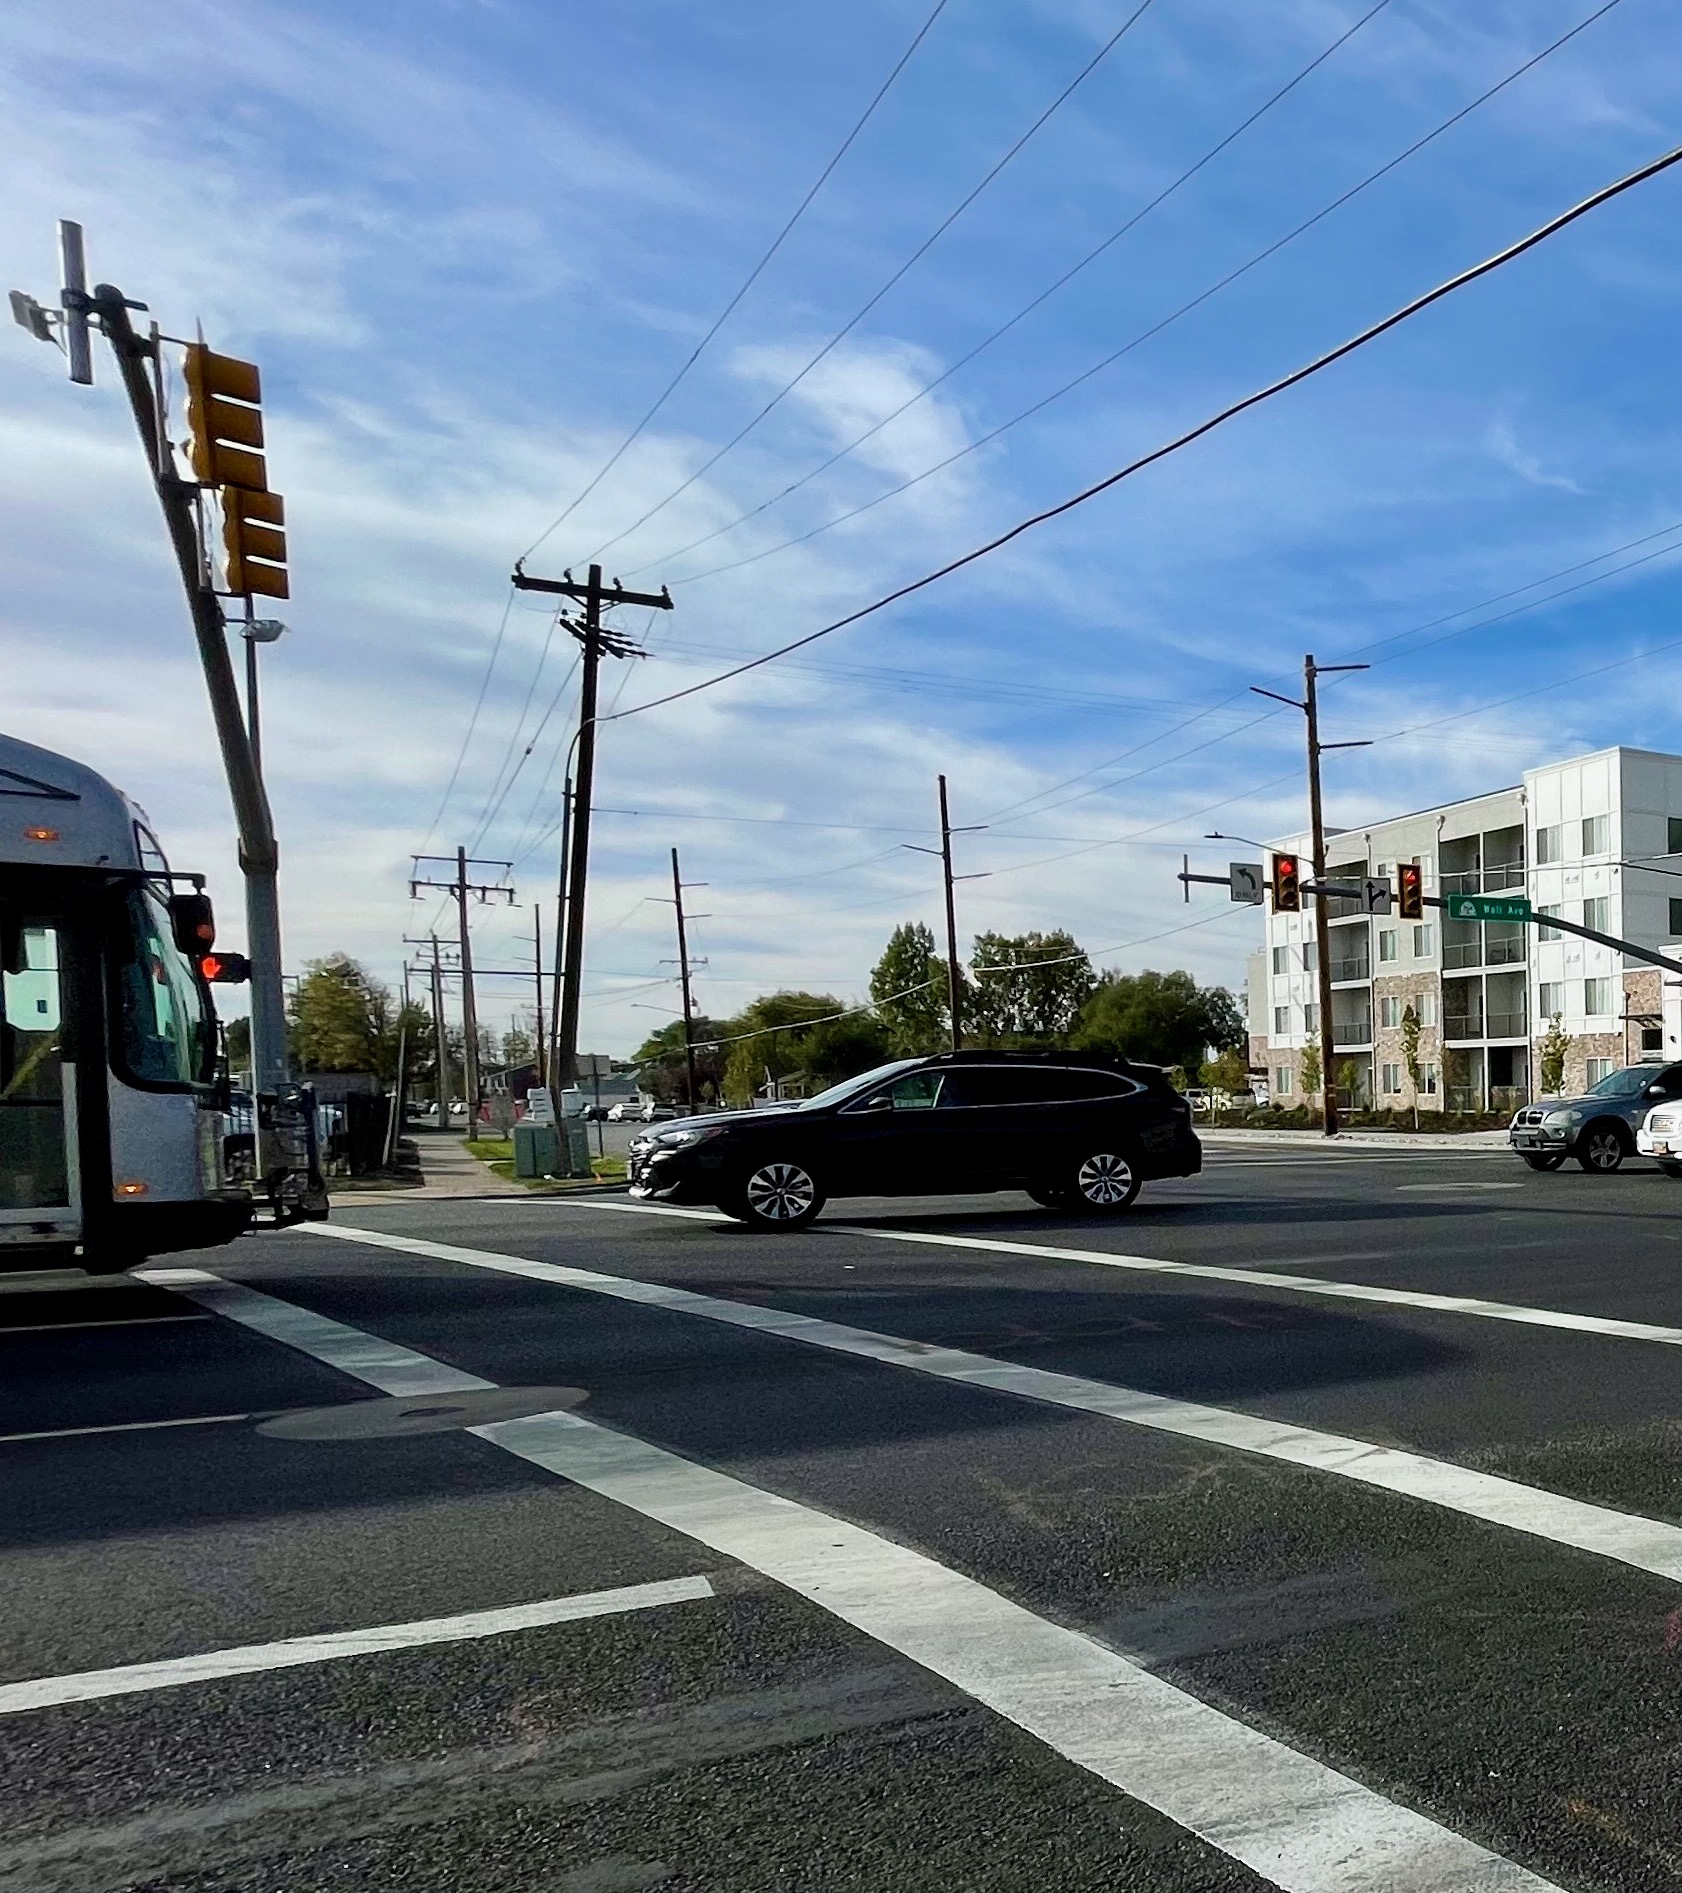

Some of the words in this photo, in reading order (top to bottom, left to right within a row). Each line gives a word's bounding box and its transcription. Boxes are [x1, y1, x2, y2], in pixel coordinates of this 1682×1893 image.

[1235, 891, 1259, 900] ONLY
[1483, 904, 1503, 915] Wall
[1507, 905, 1524, 916] Ave
